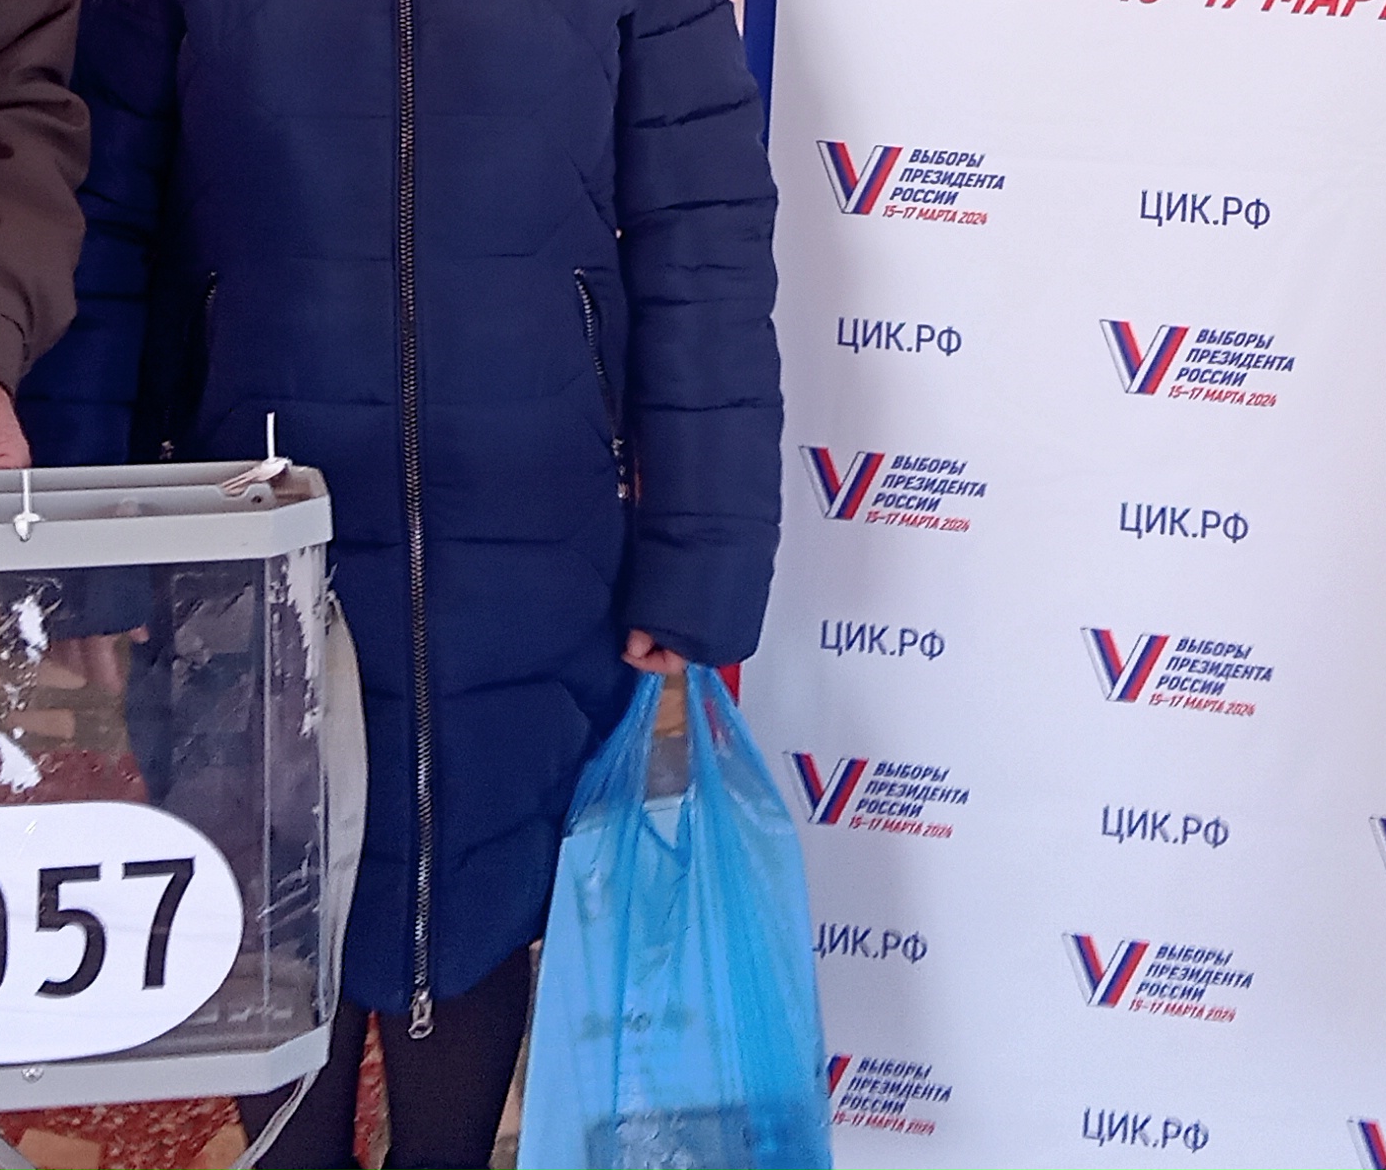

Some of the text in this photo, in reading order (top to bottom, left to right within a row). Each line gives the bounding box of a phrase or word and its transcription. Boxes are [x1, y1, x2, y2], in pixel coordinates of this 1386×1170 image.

[909, 149, 986, 168] ВЫБОРЫ
[899, 168, 1007, 189] ПРЕЗИДЕНТА
[890, 187, 959, 205] РОССИИ
[916, 208, 958, 223] МАРТА
[958, 212, 989, 226] 2024
[1140, 190, 1271, 230] ЦИК.РФ
[836, 316, 962, 357] ЦИК.РФ
[1195, 329, 1275, 348] ВЫБОРЫ
[1185, 348, 1296, 371] ПРЕЗИДЕНТА
[1175, 368, 1247, 386] РОССИИ
[1202, 389, 1245, 404] МАРТА
[1245, 393, 1277, 407] 2024
[891, 455, 968, 475] ВЫБОРЫ
[882, 474, 989, 497] ПРЕЗИДЕНТА
[873, 493, 942, 512] РОССИИ
[898, 514, 940, 530] МАРТА
[941, 519, 972, 533] 2024
[1119, 502, 1249, 544] ЦИК.РФ
[819, 619, 945, 661] ЦИК.РФ
[1174, 638, 1253, 658] ВЫБОРЫ
[1165, 657, 1274, 681] ПРЕЗИДЕНТА
[1155, 676, 1225, 695] РОССИИ
[1181, 697, 1224, 713] МАРТА
[1224, 702, 1255, 716] 2024
[874, 762, 950, 782] ВЫБОРЫ
[864, 781, 971, 805] ПРЕЗИДЕНТА
[856, 799, 924, 819] РОССИИ
[1101, 805, 1229, 849] ЦИК.РФ
[1082, 1108, 1209, 1154] ЦИК.РФ
